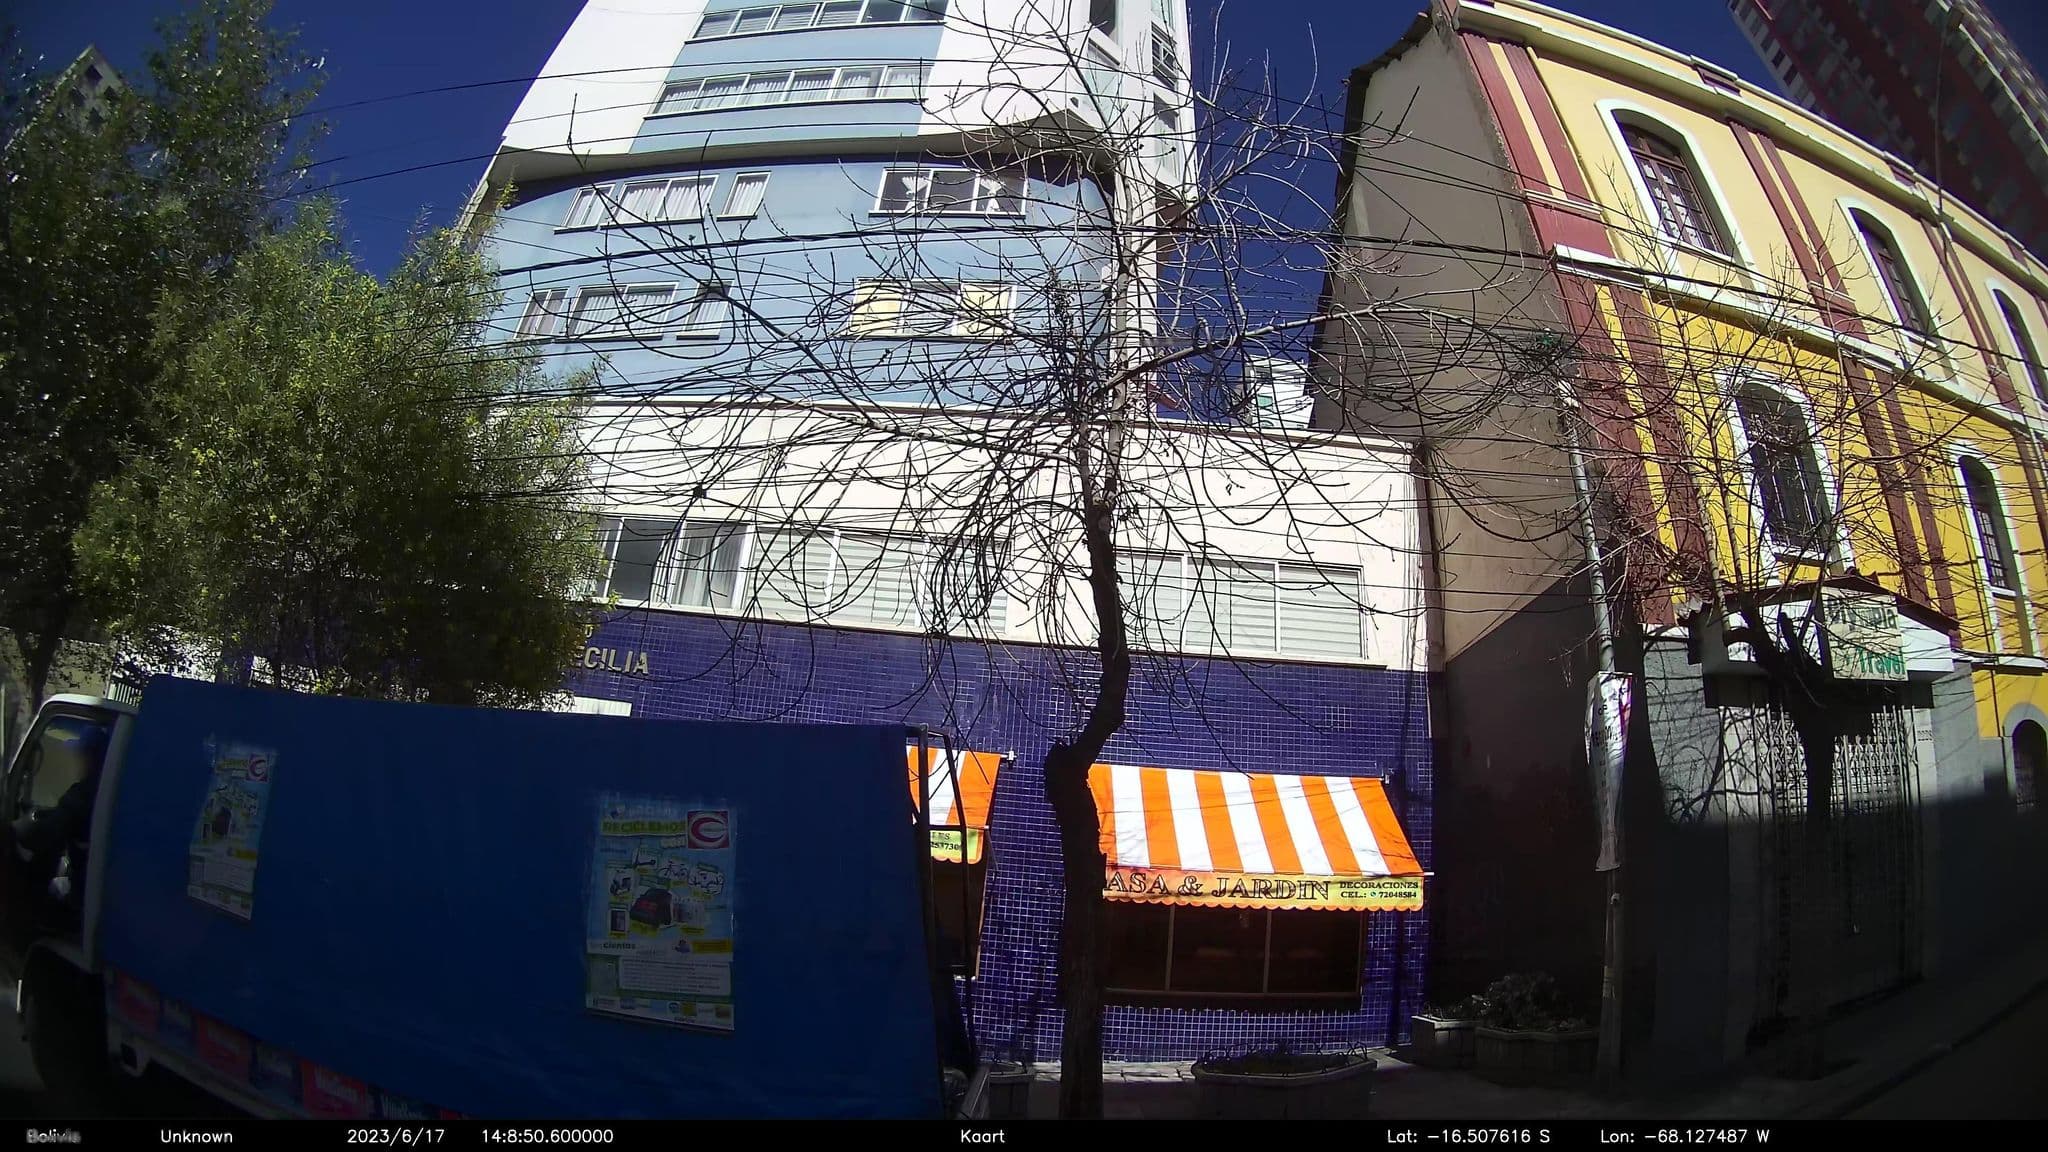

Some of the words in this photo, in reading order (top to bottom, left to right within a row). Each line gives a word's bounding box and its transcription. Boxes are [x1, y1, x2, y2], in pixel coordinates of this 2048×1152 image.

[1178, 875, 1204, 897] &
[1211, 877, 1331, 901] JARDIN
[1339, 881, 1419, 889] DECORACIONES
